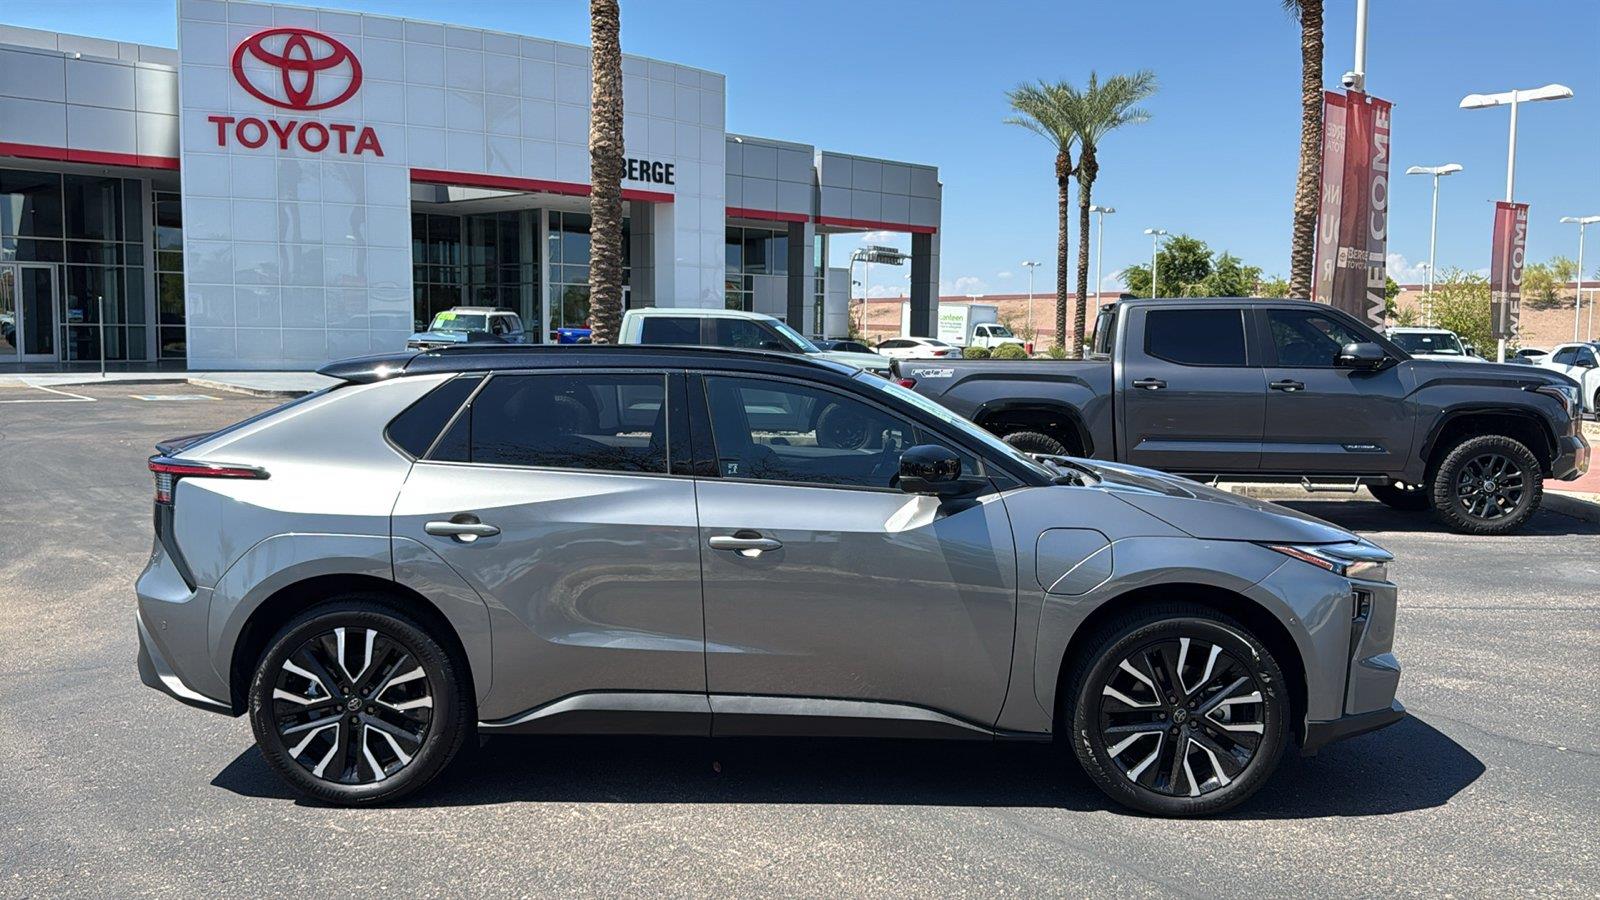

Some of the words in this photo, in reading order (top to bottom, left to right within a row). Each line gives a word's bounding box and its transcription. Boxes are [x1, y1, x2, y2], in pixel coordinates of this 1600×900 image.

[208, 116, 384, 157] TOYOTA
[1366, 105, 1389, 333] WELCOME
[1510, 206, 1527, 340] WELCOME
